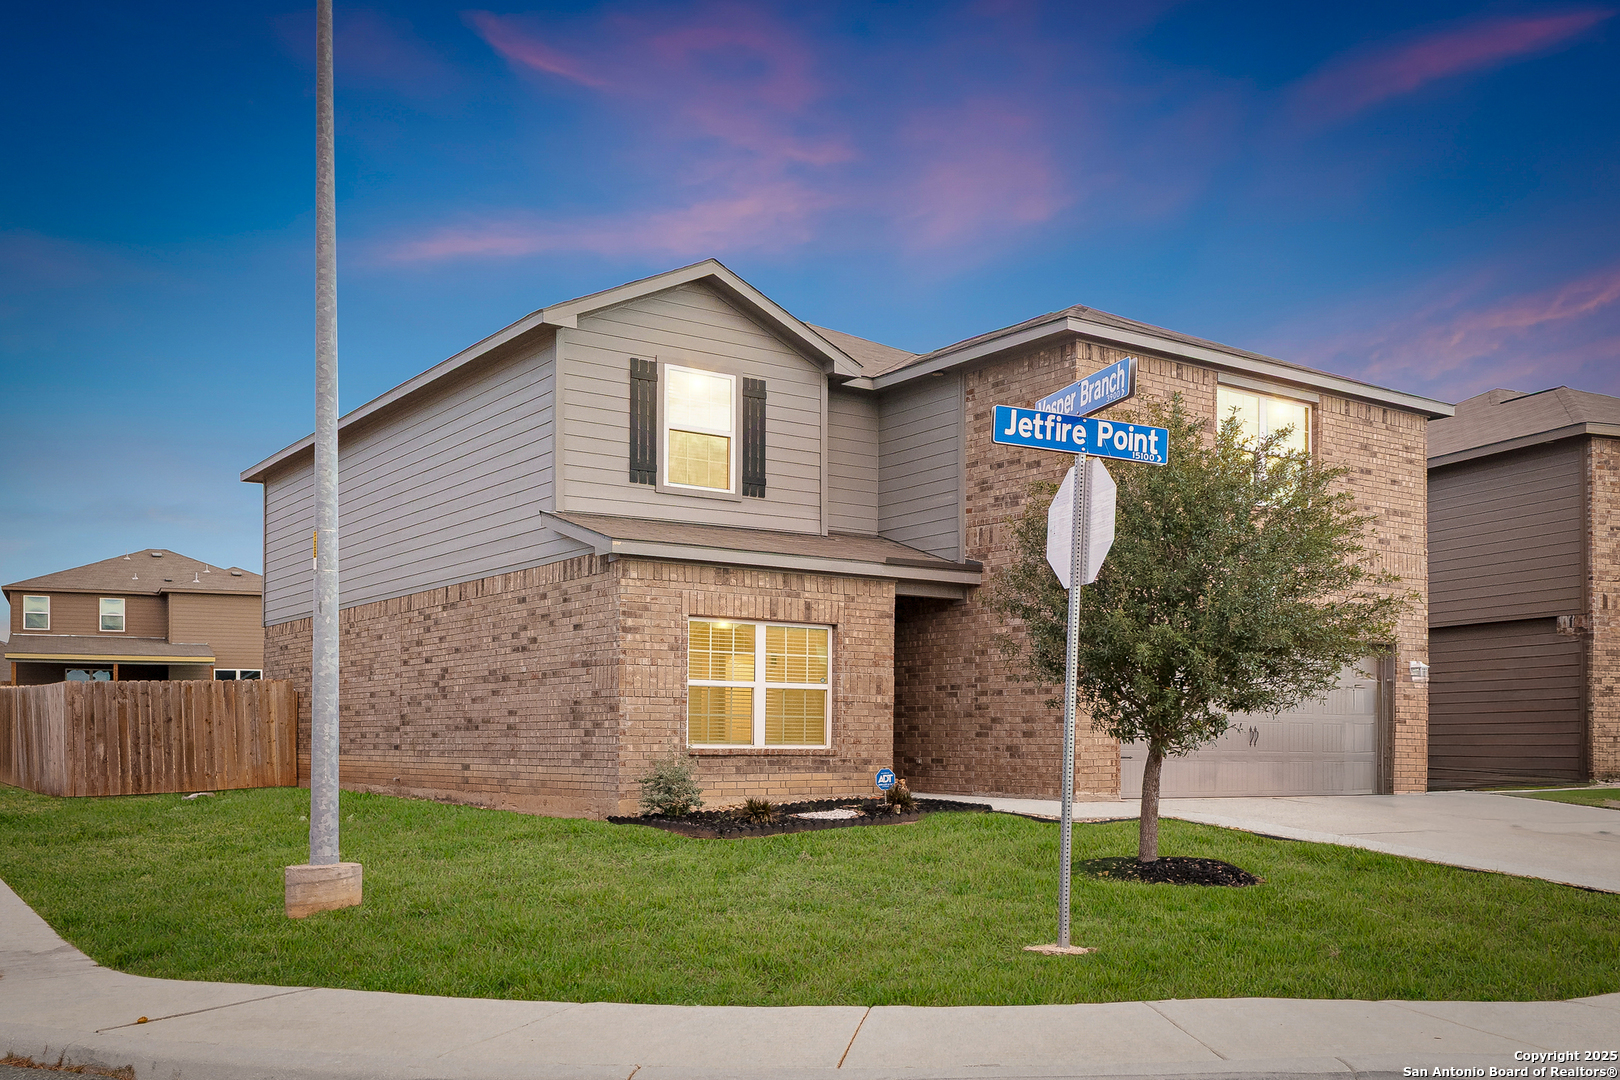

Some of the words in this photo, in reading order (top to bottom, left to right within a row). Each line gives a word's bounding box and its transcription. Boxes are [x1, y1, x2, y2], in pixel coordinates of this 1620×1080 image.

[1080, 364, 1125, 407] Branch
[1106, 390, 1120, 402] 3900
[1004, 409, 1087, 445] Jetfire
[1097, 420, 1159, 455] Point
[1132, 451, 1155, 461] 15100
[878, 774, 893, 783] ADT
